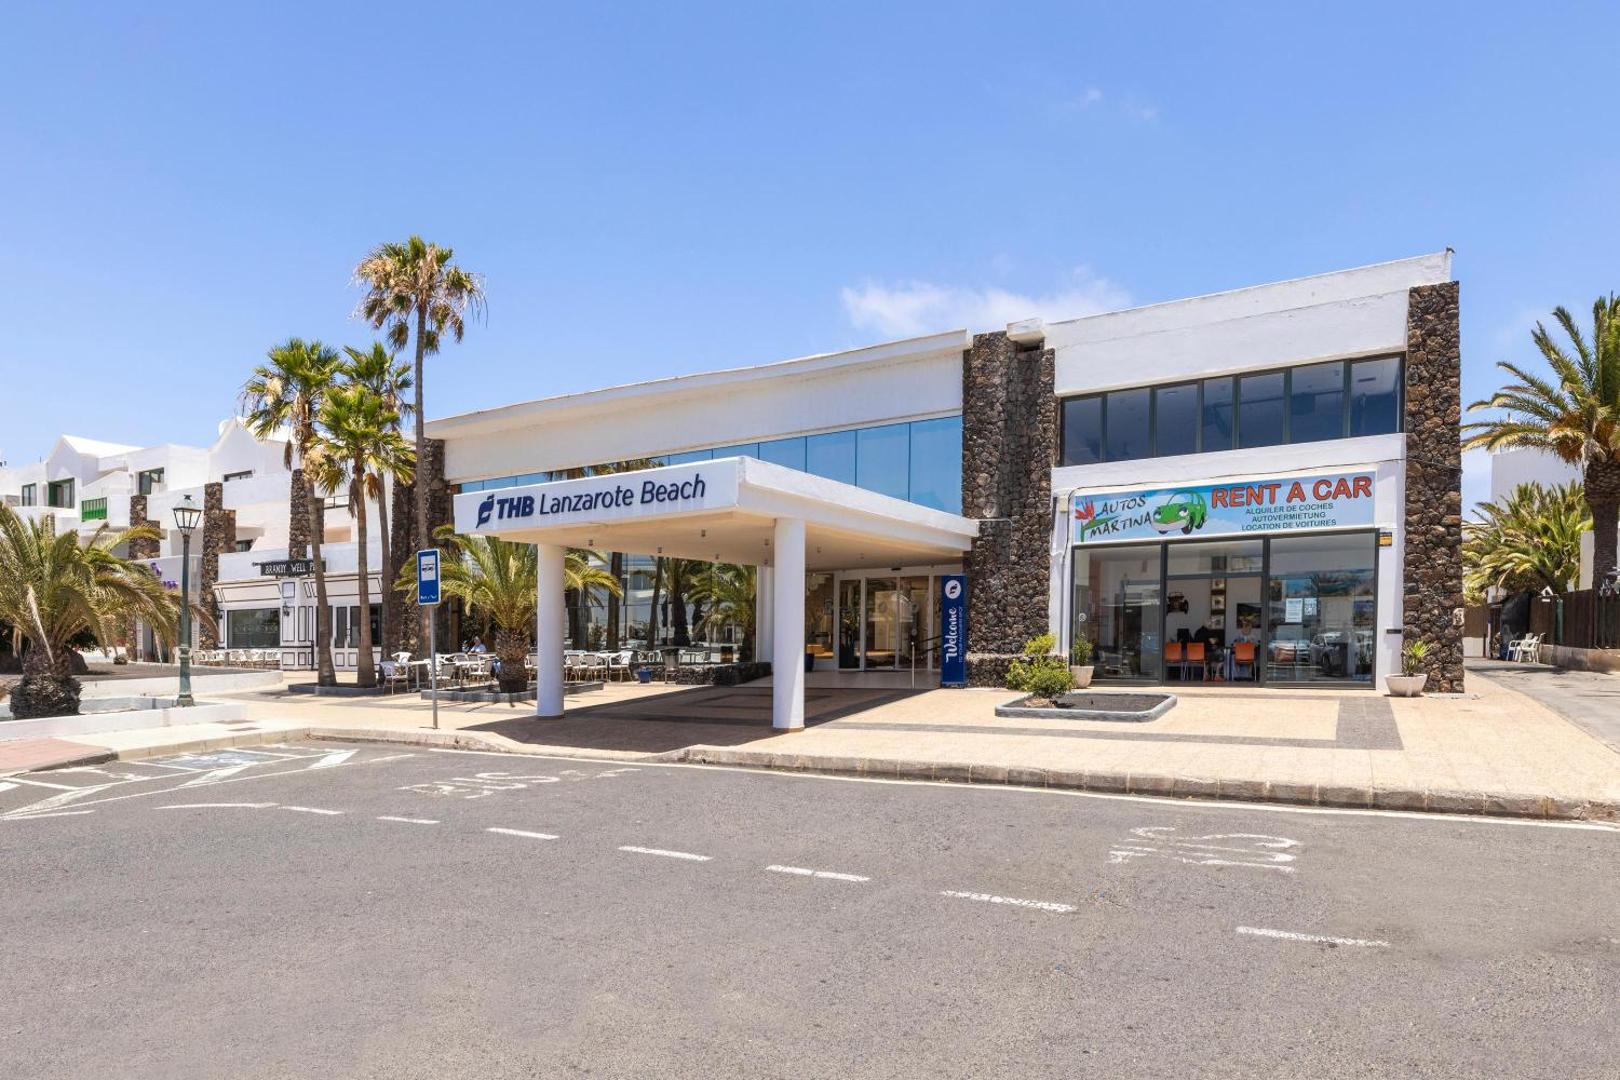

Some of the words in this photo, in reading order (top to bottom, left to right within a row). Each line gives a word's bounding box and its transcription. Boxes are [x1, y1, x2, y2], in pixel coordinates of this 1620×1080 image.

[497, 494, 534, 519] THB
[540, 485, 634, 515] Lanzarote
[640, 473, 706, 504] Beach
[1211, 483, 1281, 508] RENT
[1286, 481, 1306, 502] A
[1312, 476, 1373, 501] CAR
[1100, 494, 1146, 516] AUTOS
[1246, 504, 1285, 515] ALQUILER
[1286, 504, 1297, 512] DE
[1299, 502, 1334, 511] COCHES
[1090, 511, 1152, 538] MARTINA
[1241, 521, 1281, 531] LOCATION
[1282, 521, 1294, 529] DE
[1294, 518, 1337, 528] VOITURES
[1252, 511, 1326, 522] AUTOVERMIETUNG
[291, 562, 306, 573] WELL
[944, 607, 959, 663] Welcome
